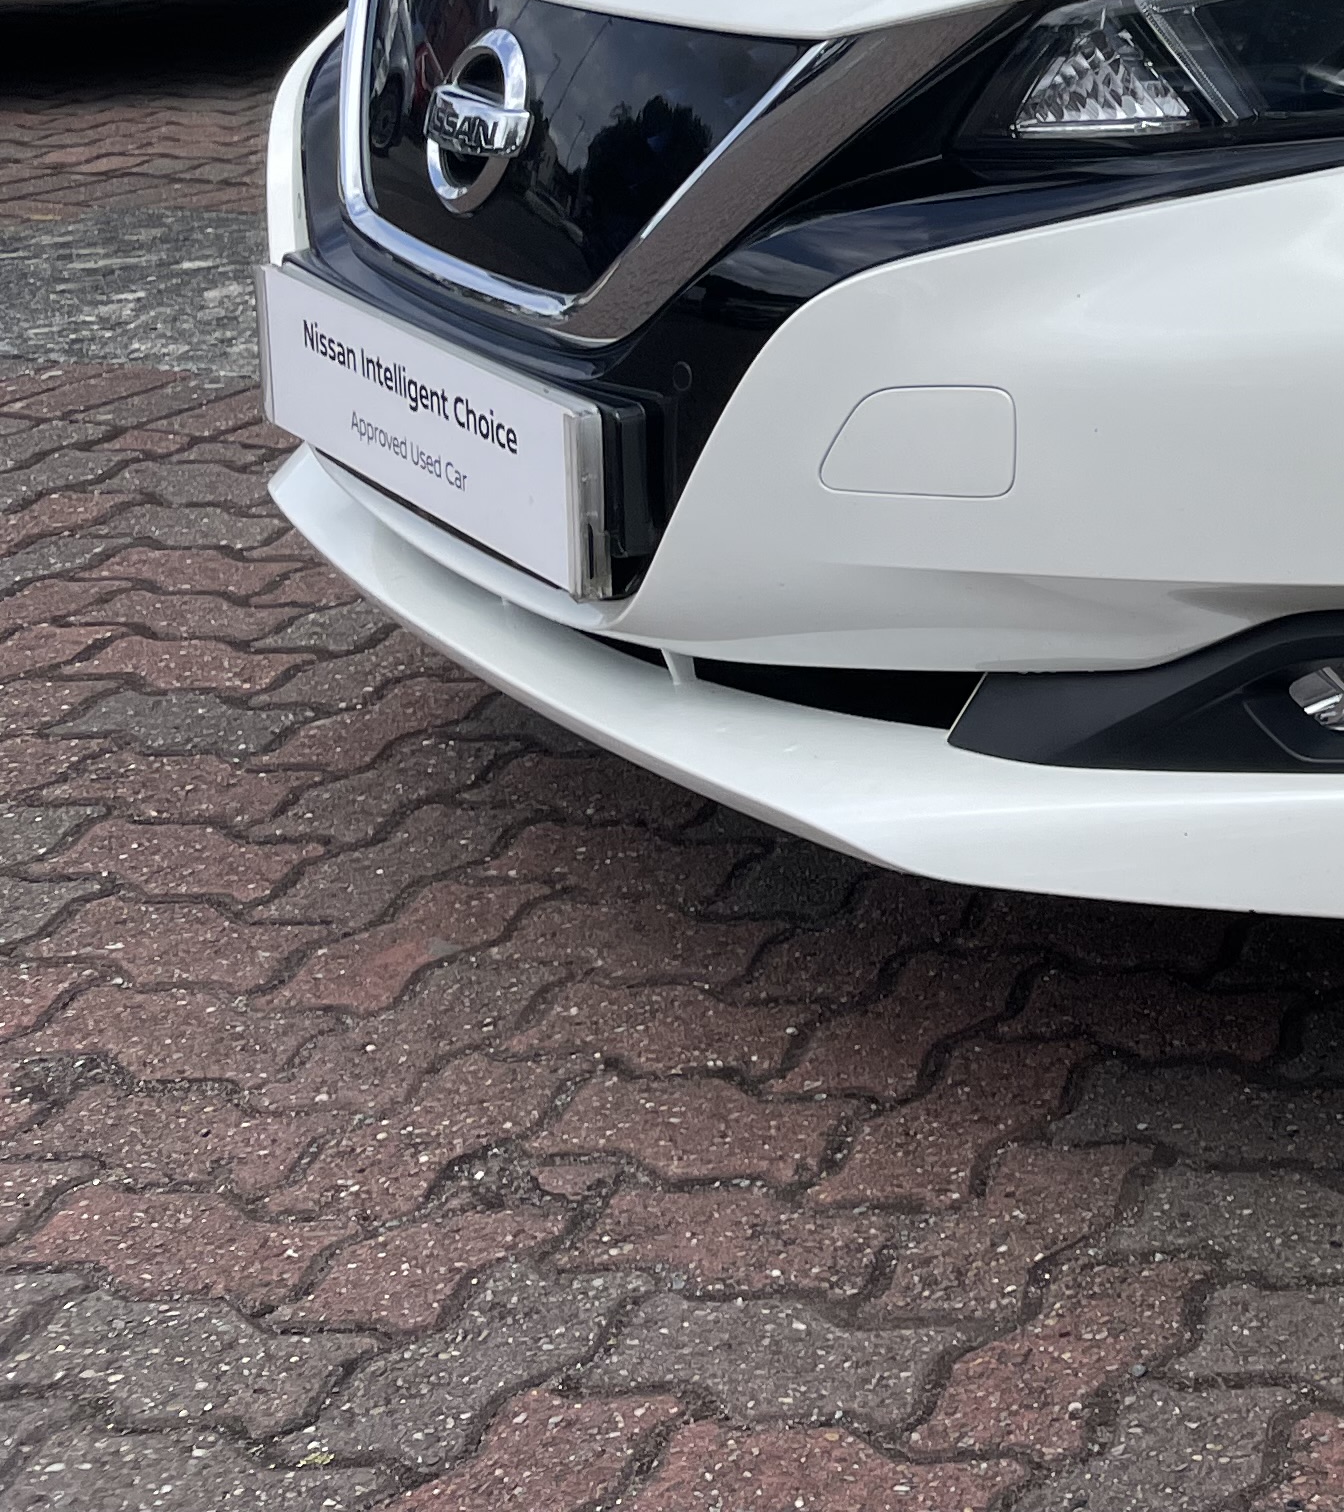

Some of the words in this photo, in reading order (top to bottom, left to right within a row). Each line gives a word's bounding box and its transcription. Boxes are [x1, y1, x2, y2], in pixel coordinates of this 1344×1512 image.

[302, 319, 358, 372] Nissan
[361, 347, 450, 422] Intelligent
[453, 395, 518, 455] Choice
[350, 409, 408, 460] Approved
[410, 441, 442, 480] Used
[445, 461, 467, 492] Car
